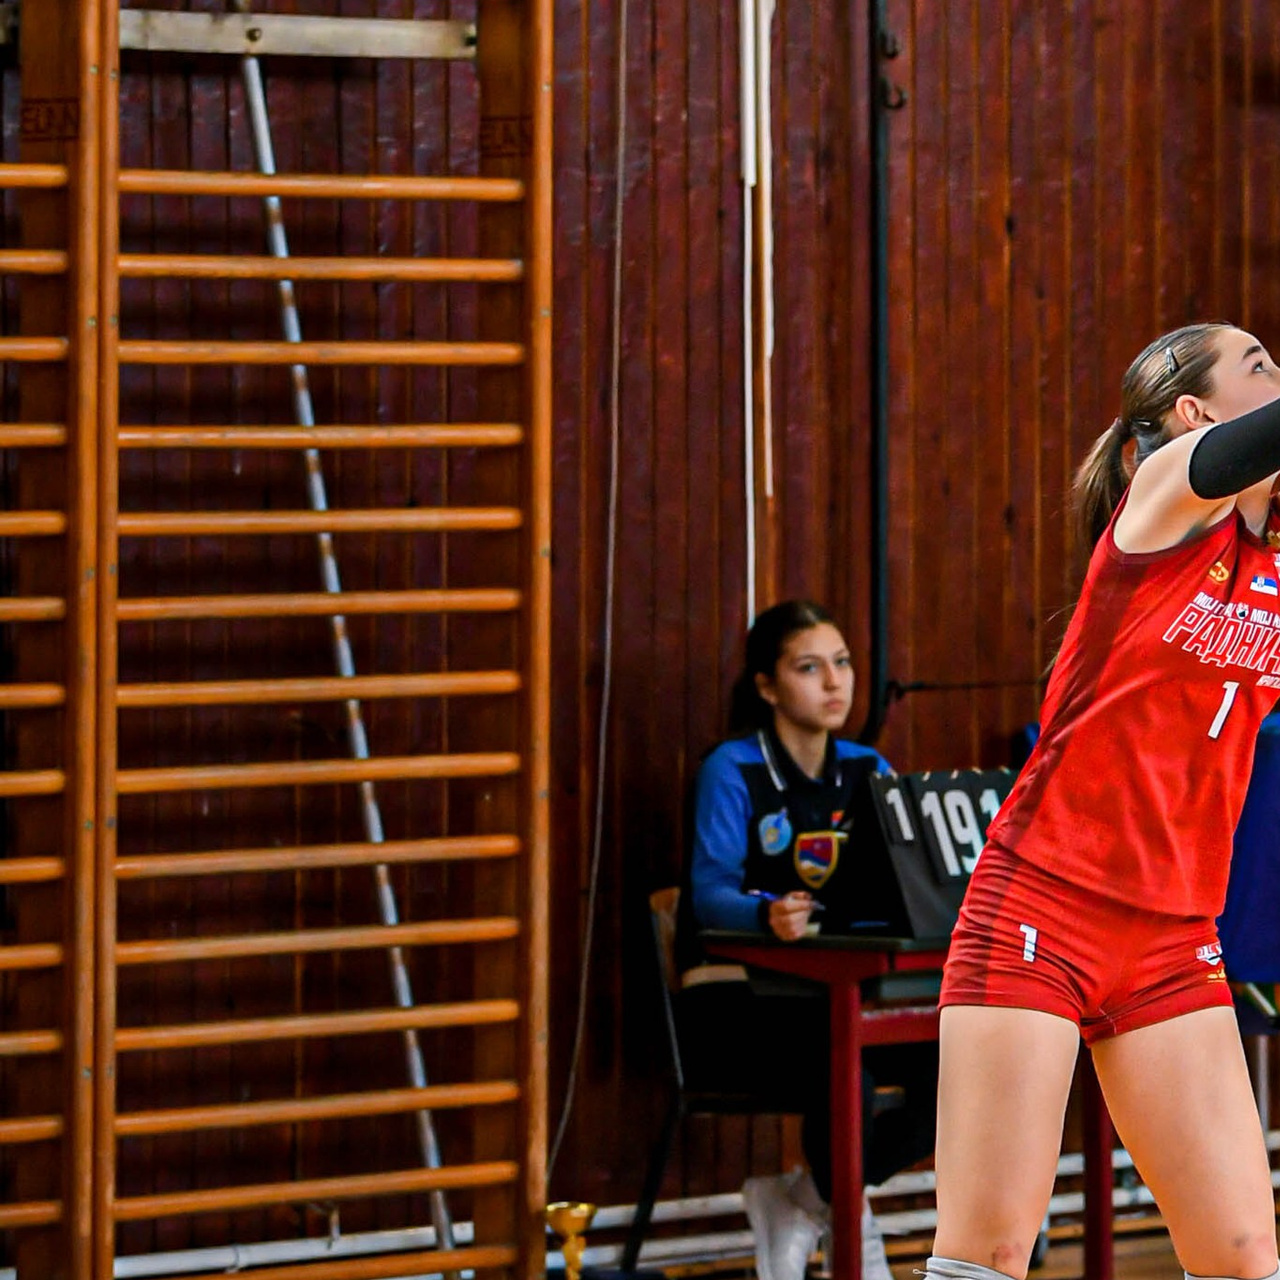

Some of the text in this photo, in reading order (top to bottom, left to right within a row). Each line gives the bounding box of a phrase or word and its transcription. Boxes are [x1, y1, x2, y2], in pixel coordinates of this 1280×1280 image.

[1207, 681, 1240, 739] 1
[885, 788, 914, 841] 1
[921, 789, 986, 877] 19
[1019, 923, 1038, 963] 1
